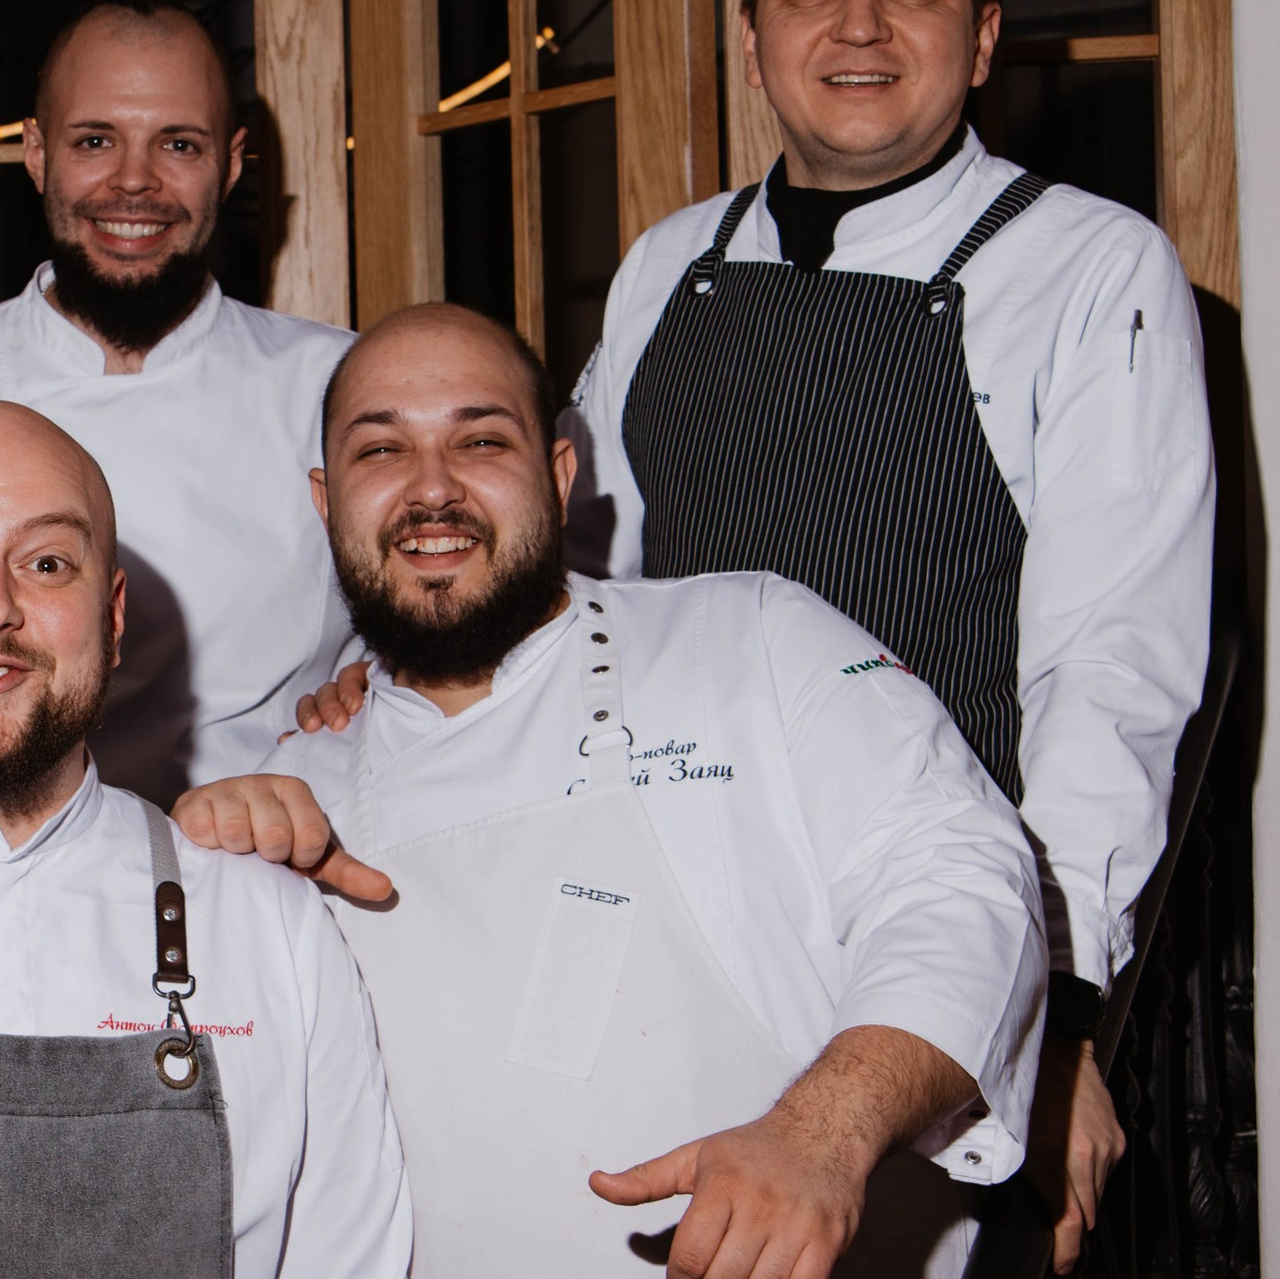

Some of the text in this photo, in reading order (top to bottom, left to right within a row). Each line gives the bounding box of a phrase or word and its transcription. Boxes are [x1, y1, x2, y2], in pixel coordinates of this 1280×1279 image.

[668, 758, 734, 783] Заяц
[560, 883, 630, 906] CHEF
[97, 1013, 155, 1033] Антон
